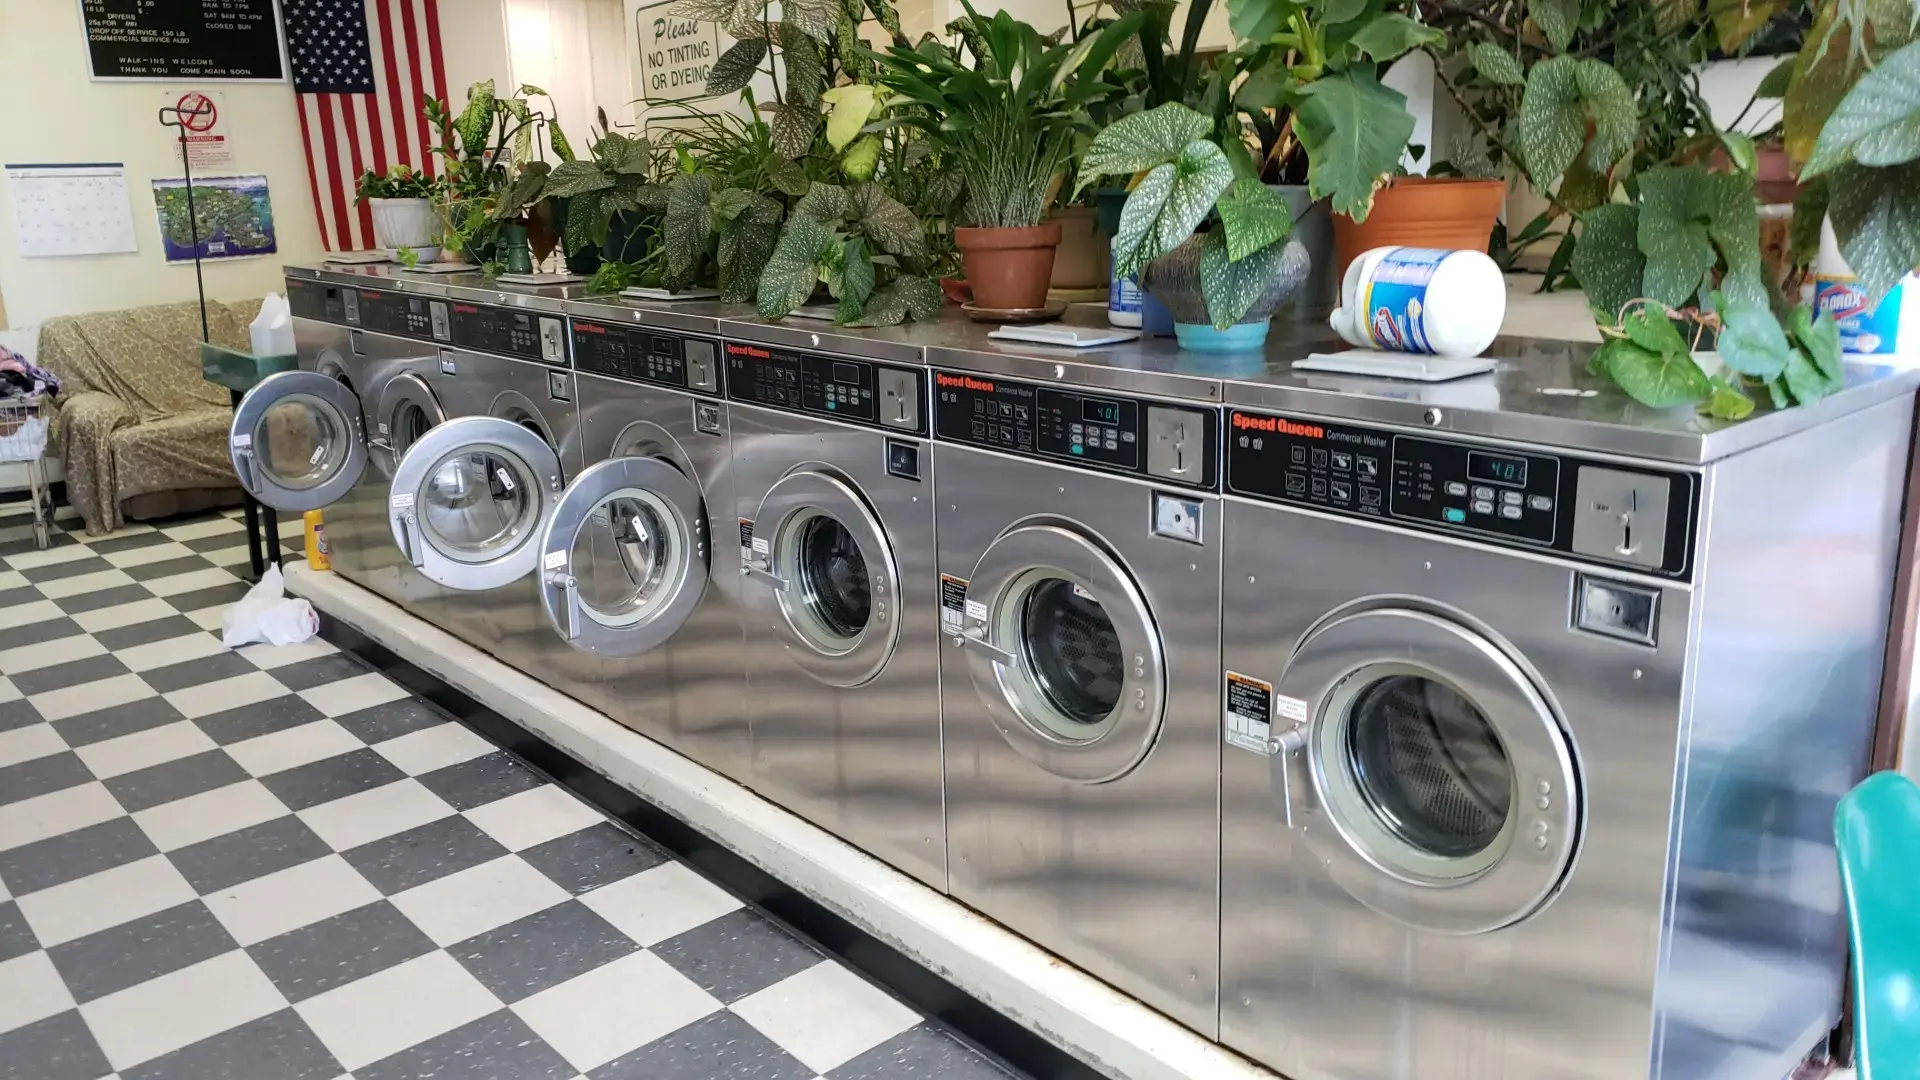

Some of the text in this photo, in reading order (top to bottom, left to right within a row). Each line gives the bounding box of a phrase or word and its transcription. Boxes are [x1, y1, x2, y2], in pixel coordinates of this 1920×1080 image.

[127, 29, 158, 37] SERVICE
[205, 22, 234, 30] CLOSED
[653, 18, 699, 46] Please
[648, 41, 710, 69] NO TINTING
[180, 67, 200, 75] COME
[652, 64, 711, 90] OR DYEING
[936, 373, 963, 387] Speed
[965, 377, 994, 392] Queen
[1209, 385, 1216, 396] 2
[1233, 413, 1387, 448] Speed Queen Commercial Washer
